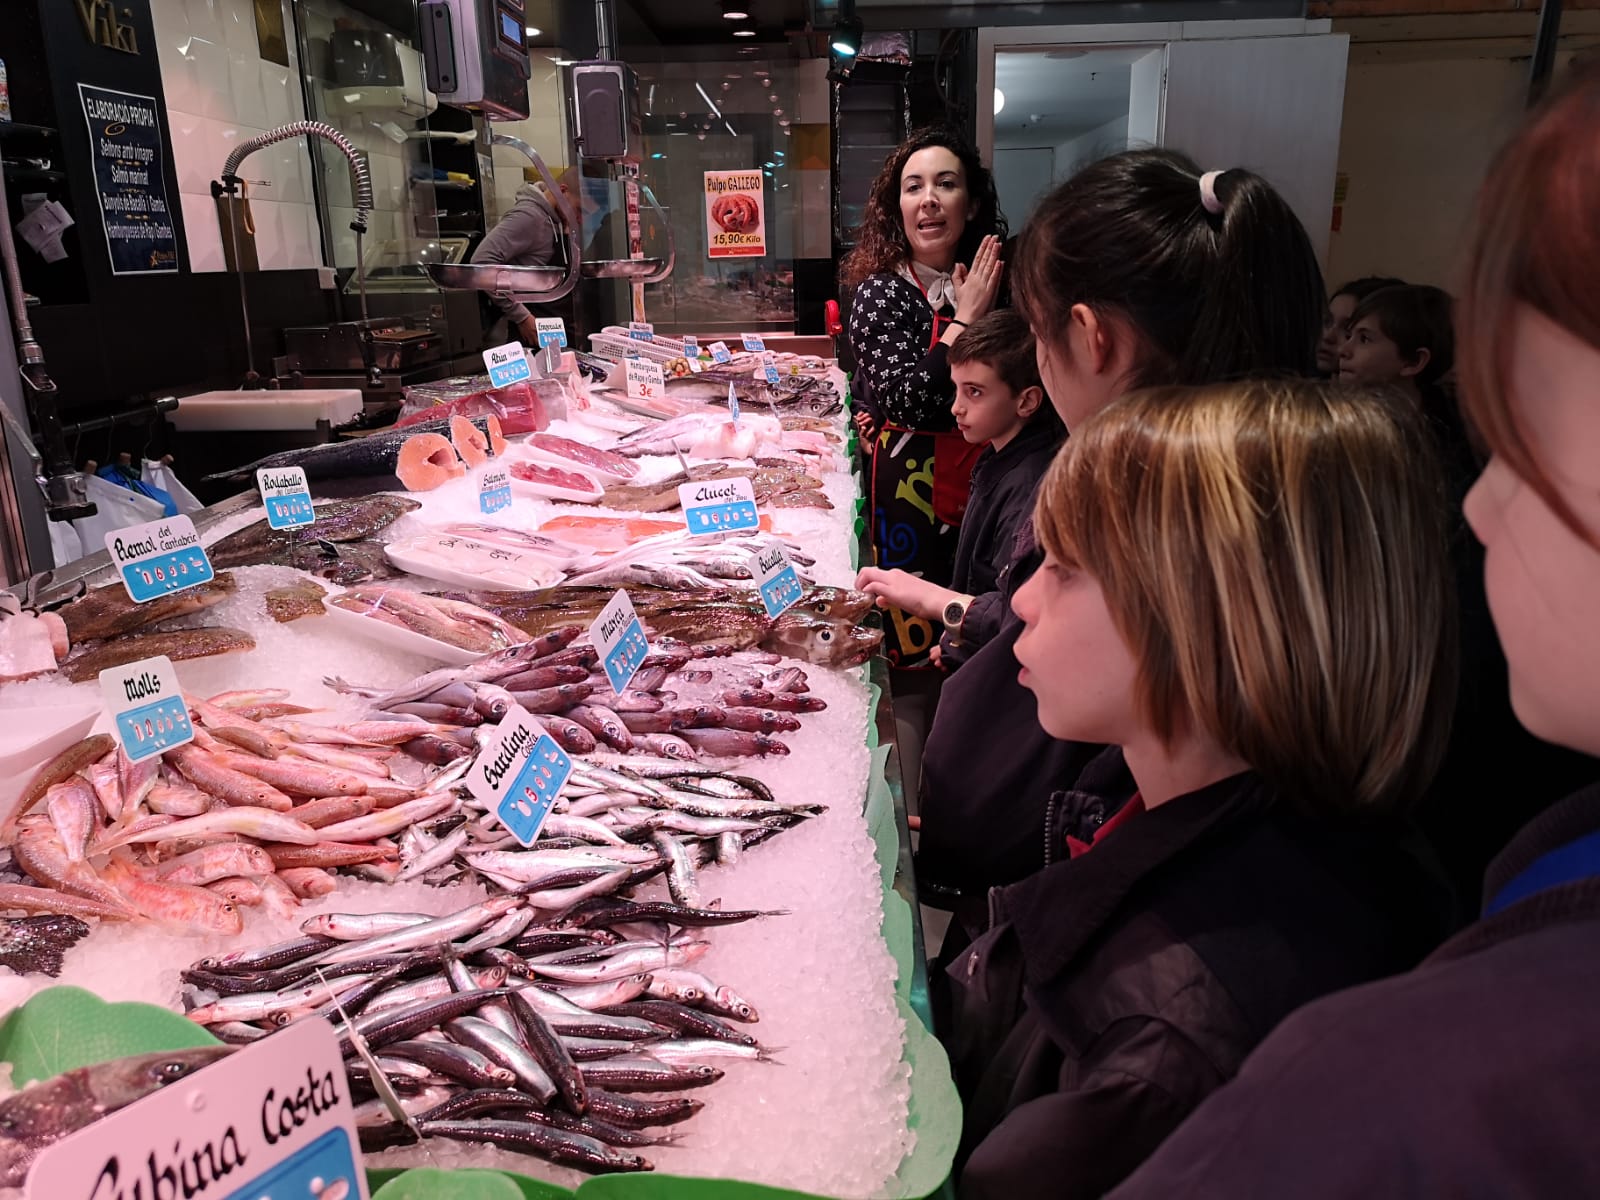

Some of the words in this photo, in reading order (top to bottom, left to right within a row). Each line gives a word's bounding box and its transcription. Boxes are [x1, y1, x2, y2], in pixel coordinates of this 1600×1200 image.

[122, 141, 134, 160] amb
[134, 144, 154, 165] vinagre
[707, 177, 727, 194] Pulpo
[727, 176, 760, 191] GALLEGO
[713, 233, 744, 246] 15,90€
[746, 235, 761, 243] Kilo
[263, 473, 302, 491] Rodaballo
[114, 536, 157, 561] Remol
[158, 525, 172, 538] del
[123, 671, 161, 702] Molls
[484, 723, 529, 790] Sardina
[520, 733, 538, 759] Costa
[262, 1066, 340, 1145] Costa
